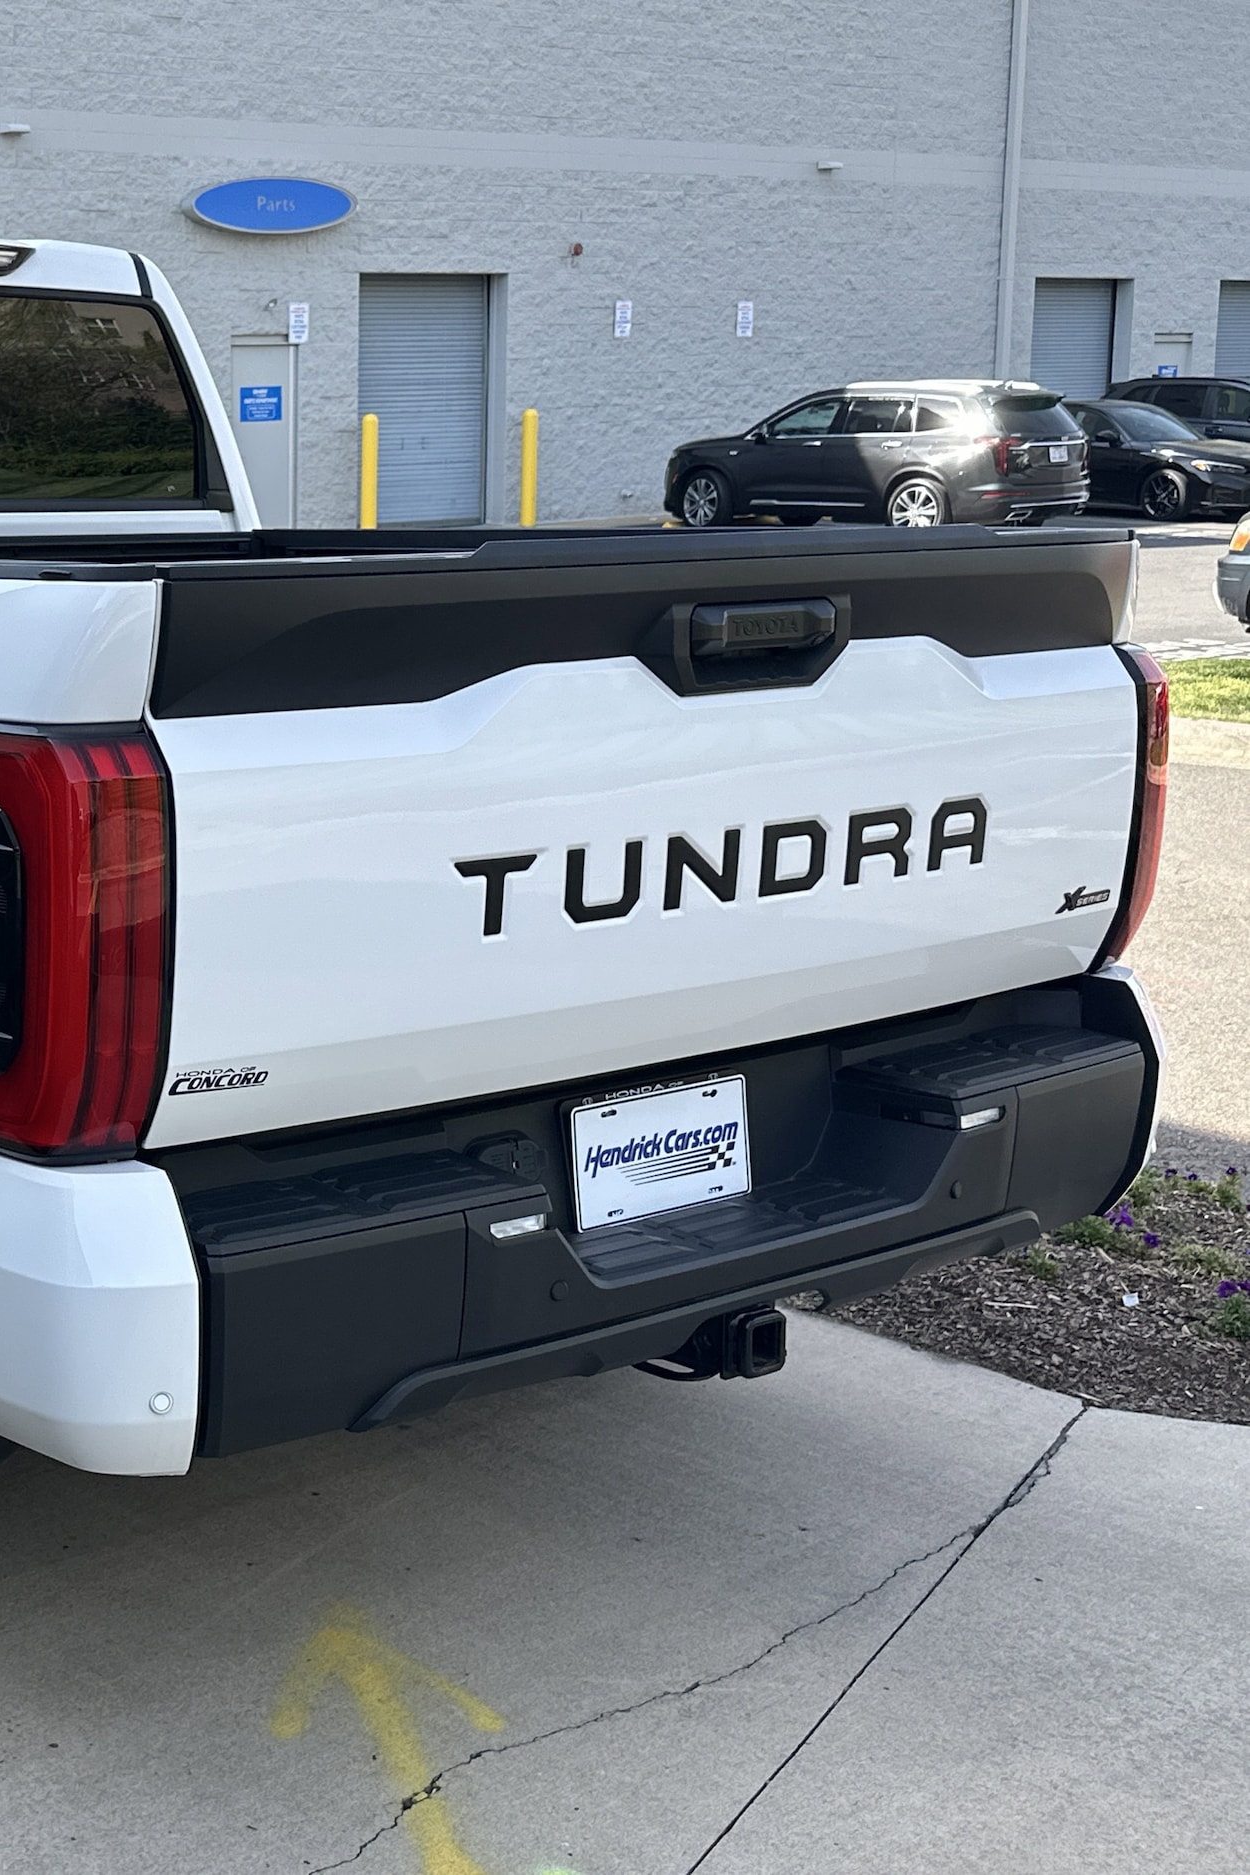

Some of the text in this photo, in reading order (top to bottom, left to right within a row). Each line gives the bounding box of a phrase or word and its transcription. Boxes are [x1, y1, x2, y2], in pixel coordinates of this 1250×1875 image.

[256, 195, 296, 211] Parts
[732, 615, 799, 637] TOYOTA
[453, 796, 989, 937] TUNDRA
[176, 1068, 236, 1078] HONDA
[168, 1071, 269, 1096] CONCORD
[605, 1082, 665, 1100] HONDA
